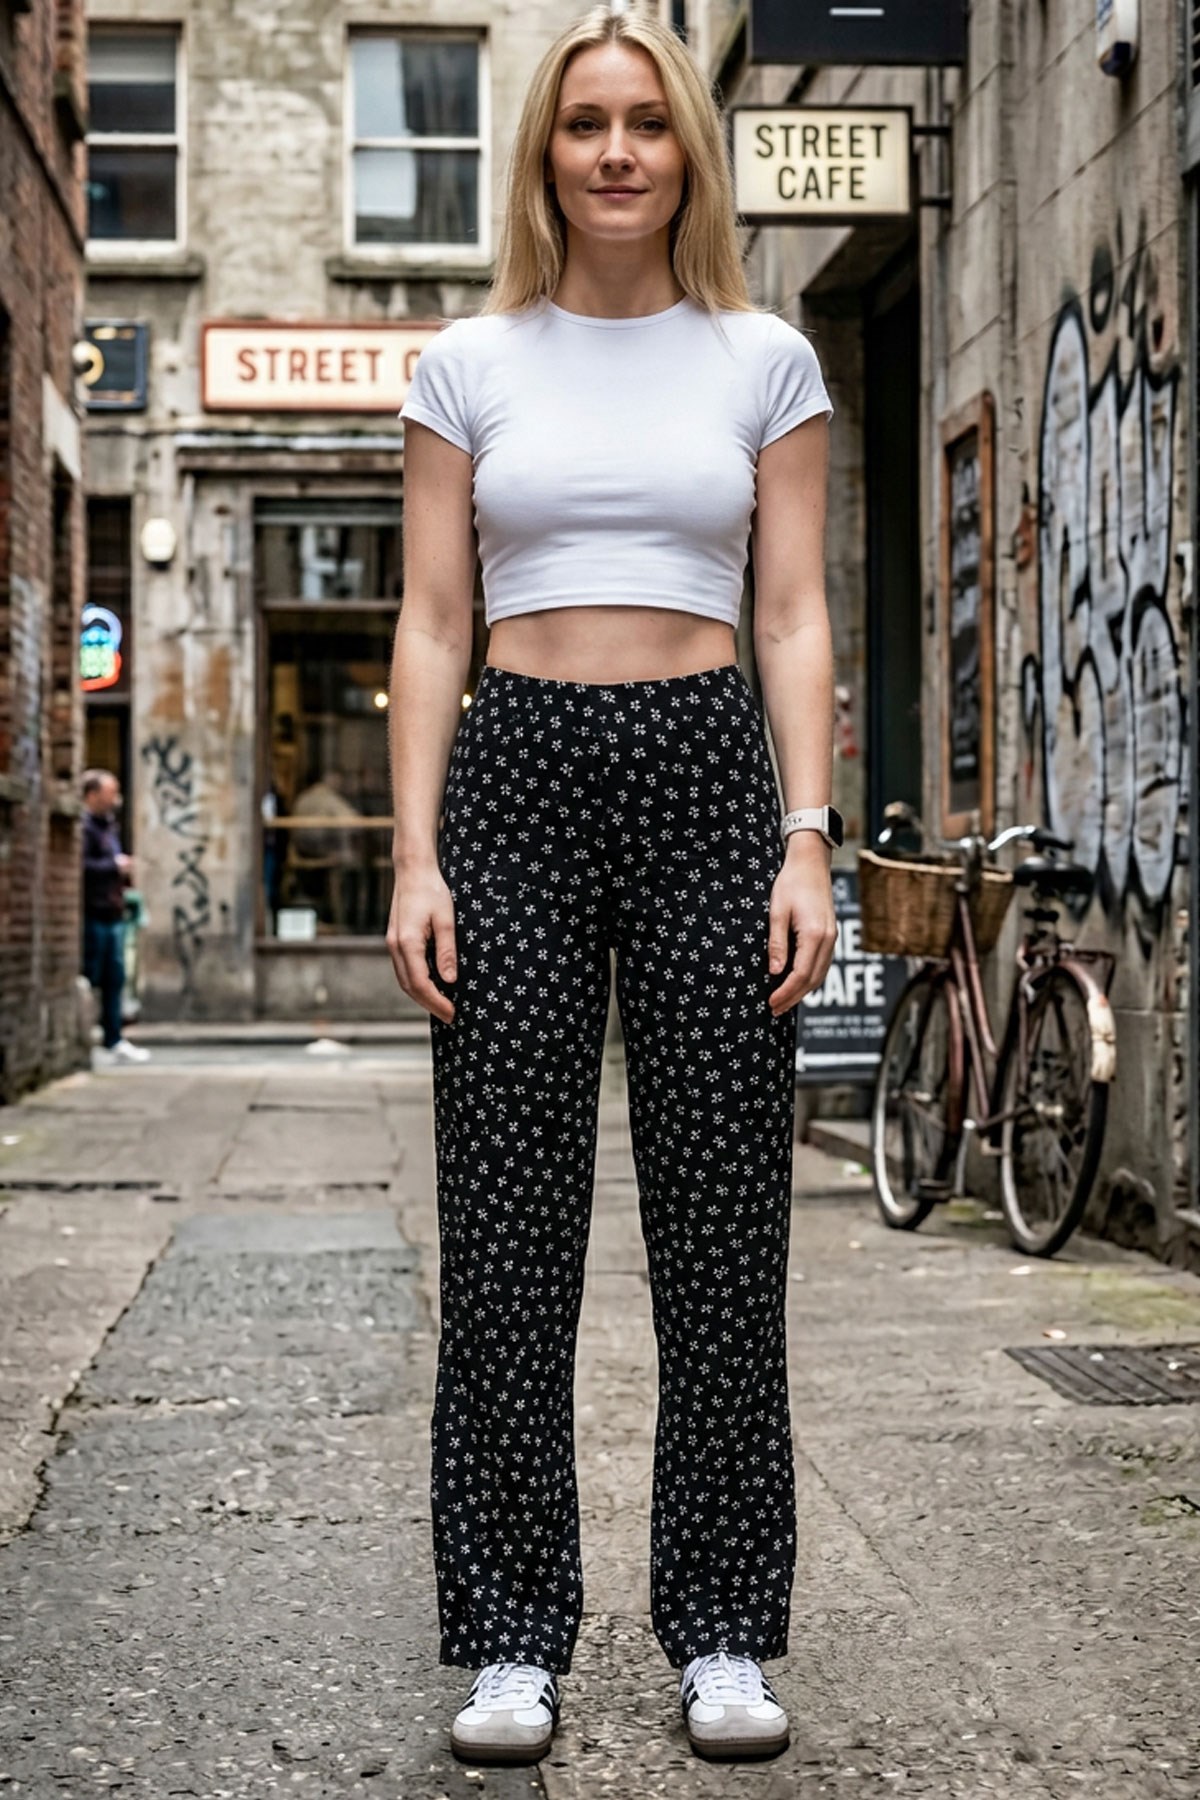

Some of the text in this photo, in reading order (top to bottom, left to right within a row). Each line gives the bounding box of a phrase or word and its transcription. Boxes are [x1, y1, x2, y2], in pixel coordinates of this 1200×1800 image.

[756, 125, 887, 158] STREET
[778, 167, 865, 200] CAFE
[237, 348, 383, 383] STREET
